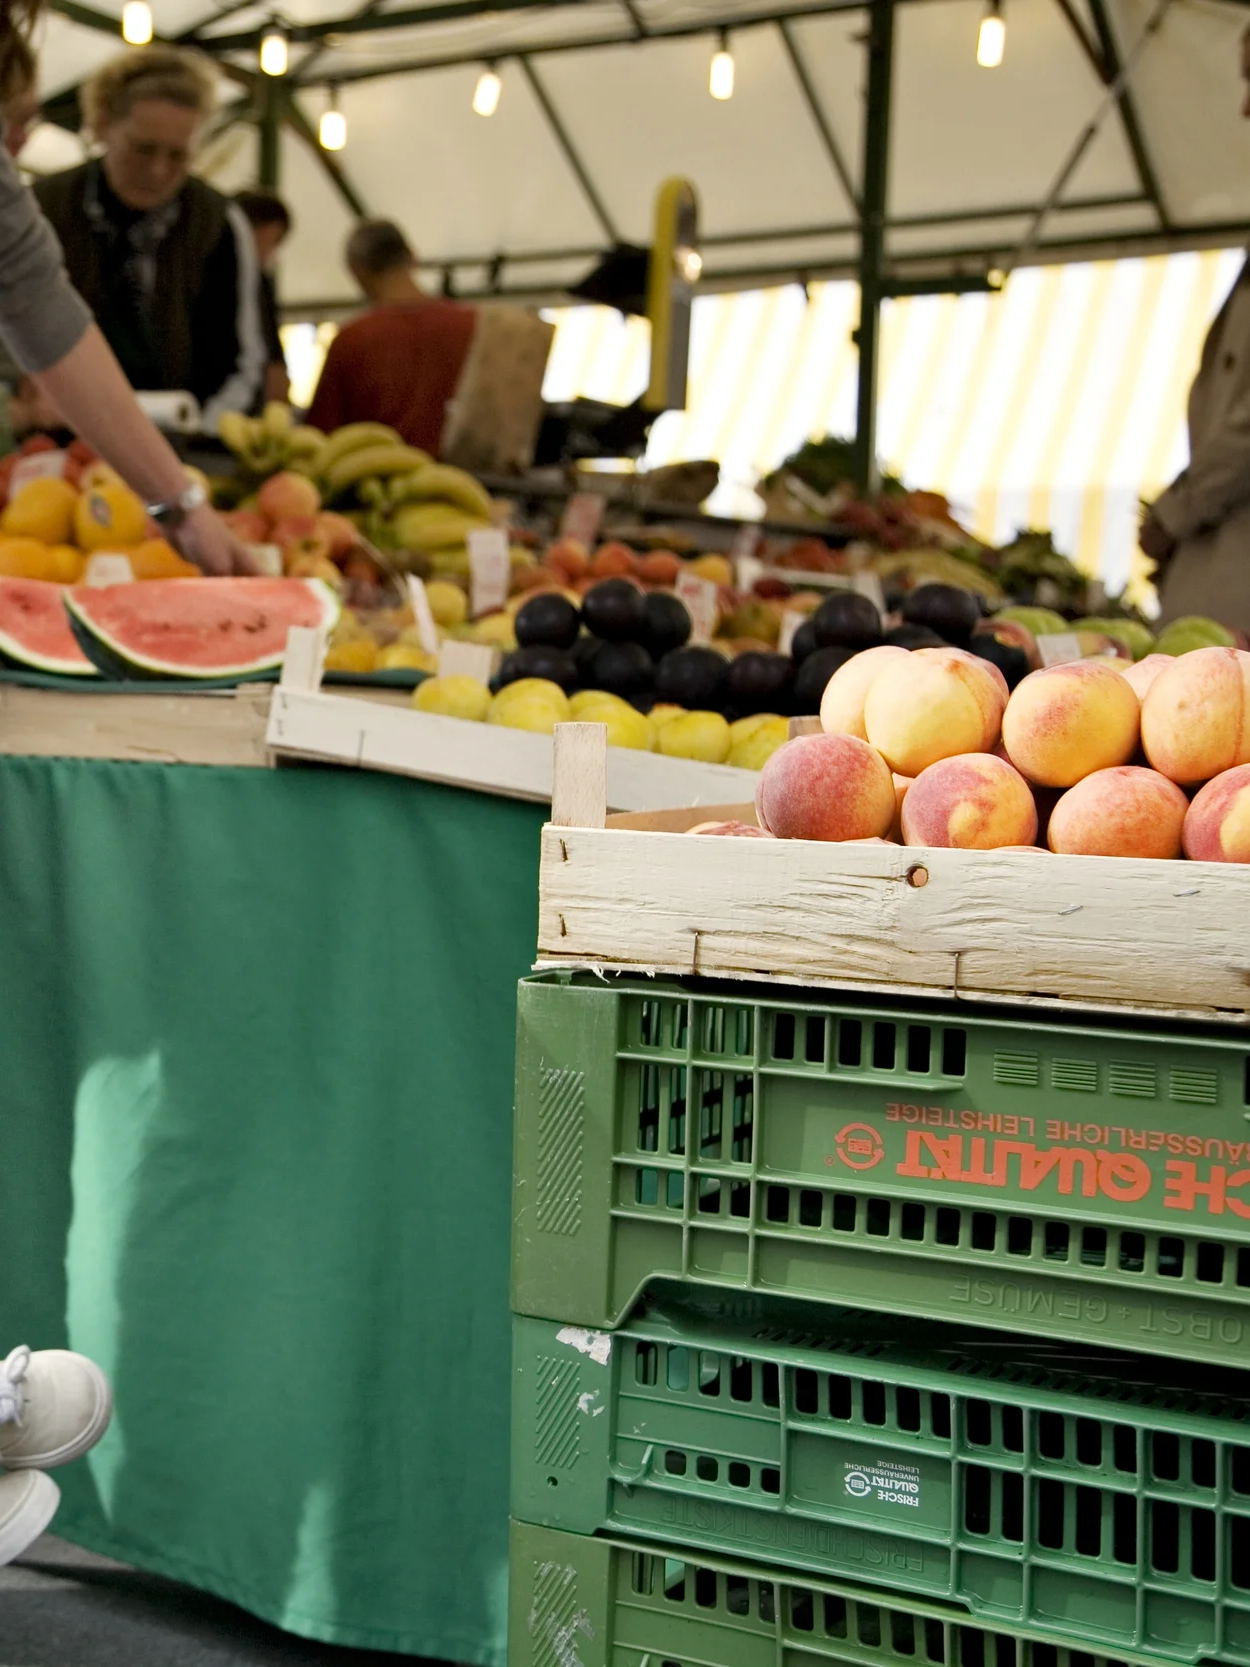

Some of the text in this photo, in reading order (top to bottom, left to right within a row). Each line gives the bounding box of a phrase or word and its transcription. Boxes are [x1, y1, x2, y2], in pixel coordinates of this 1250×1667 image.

[885, 1102, 1250, 1167] ÄUSSERLICHE LEIHSTEIGE
[949, 1273, 1108, 1324] GEMÜSE
[1139, 1302, 1244, 1344] OBST
[844, 1462, 920, 1482] UNVERÄUSSERLICHE
[877, 1460, 920, 1474] LEIHSTEIGE
[877, 1490, 919, 1507] FRISCHE
